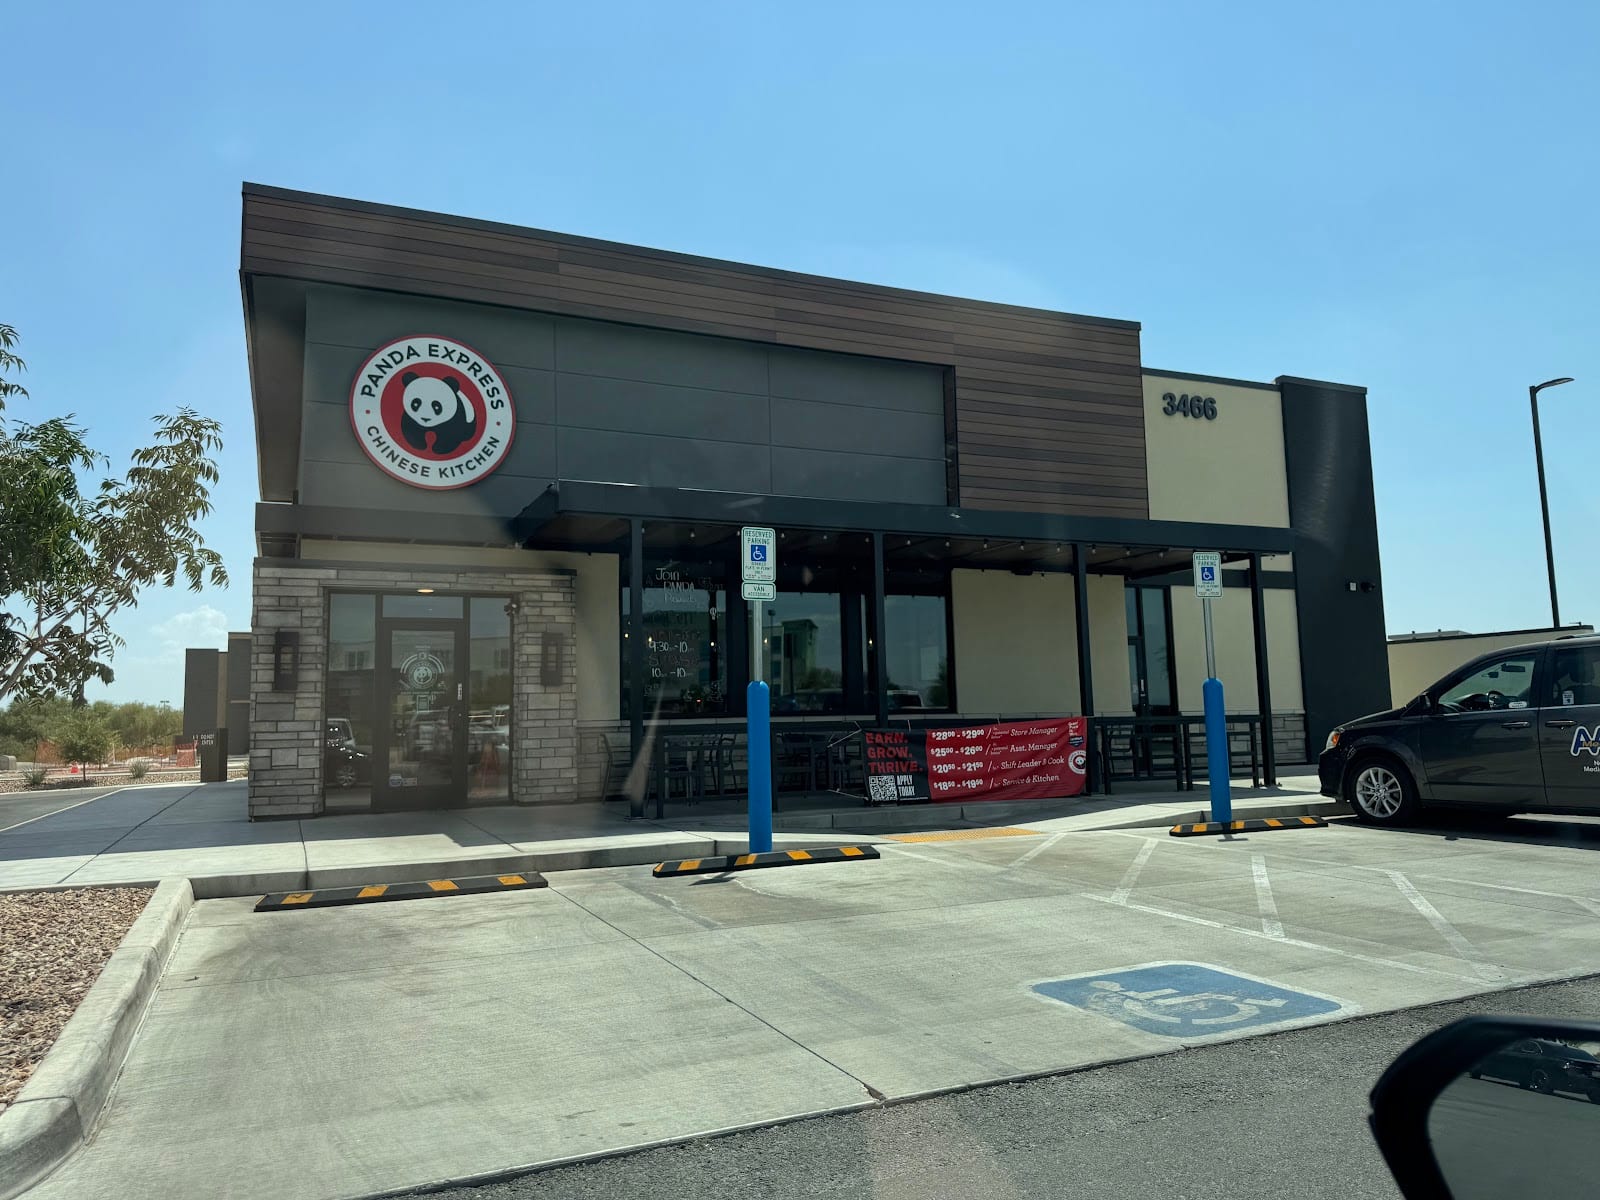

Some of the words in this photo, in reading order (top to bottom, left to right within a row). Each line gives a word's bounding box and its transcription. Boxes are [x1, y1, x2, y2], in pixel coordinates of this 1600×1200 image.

[360, 345, 421, 397] PANDA
[428, 343, 504, 410] EXPRESS
[1162, 392, 1218, 420] 3466
[367, 425, 431, 477] CHINESE
[439, 436, 500, 479] KITCHEN
[744, 530, 773, 538] RESERVED
[747, 537, 770, 545] PARKING
[865, 732, 909, 744] EARN.
[1010, 728, 1028, 737] Store
[1028, 727, 1058, 736] Manager
[867, 746, 913, 759] GROW.
[1009, 744, 1027, 753] Asst.
[1028, 742, 1058, 751] Manager
[868, 760, 923, 774] THRIVE.
[1000, 760, 1017, 770] Shift
[1017, 759, 1041, 769] Leader
[1047, 755, 1065, 765] Cook
[896, 774, 913, 786] APPLY
[1002, 778, 1025, 787] Service
[1025, 776, 1031, 784] &
[1032, 773, 1060, 783] Kitchen
[898, 785, 915, 797] TODAY
